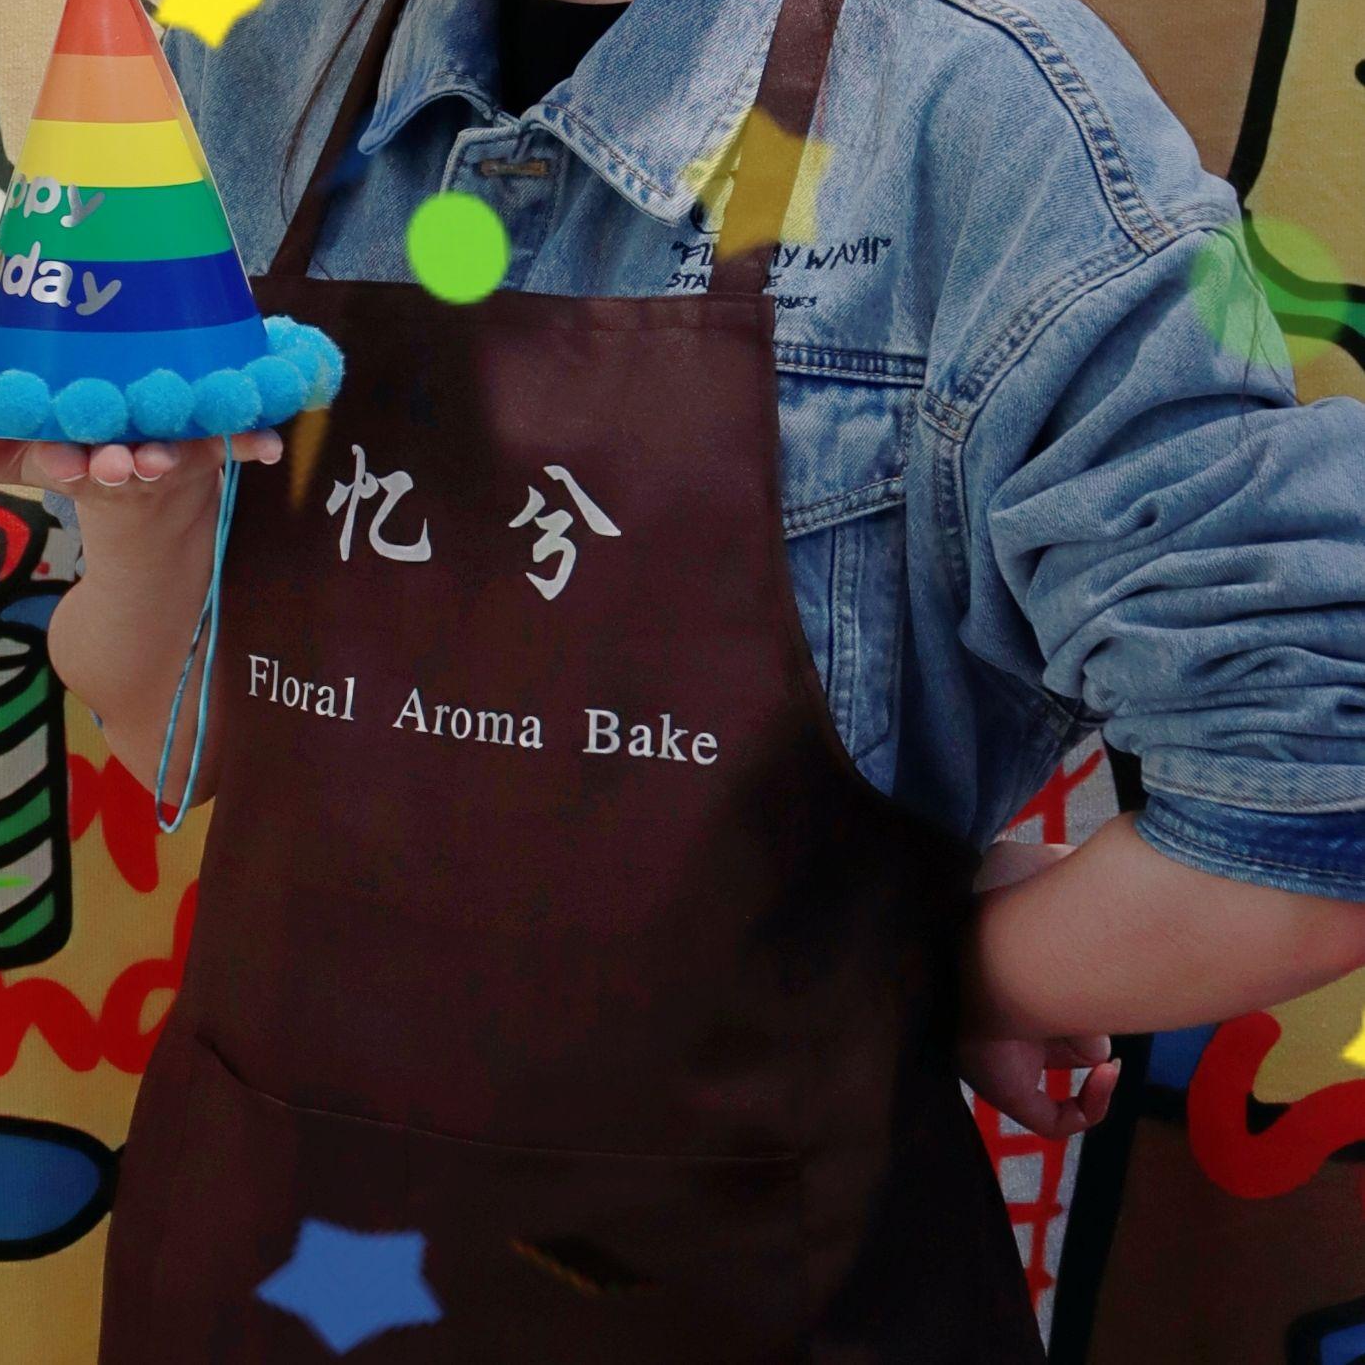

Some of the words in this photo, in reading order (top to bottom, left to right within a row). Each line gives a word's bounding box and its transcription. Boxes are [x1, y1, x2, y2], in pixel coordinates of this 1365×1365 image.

[247, 654, 356, 721] Floral
[392, 687, 544, 750] Aroma
[582, 708, 720, 766] Bake
